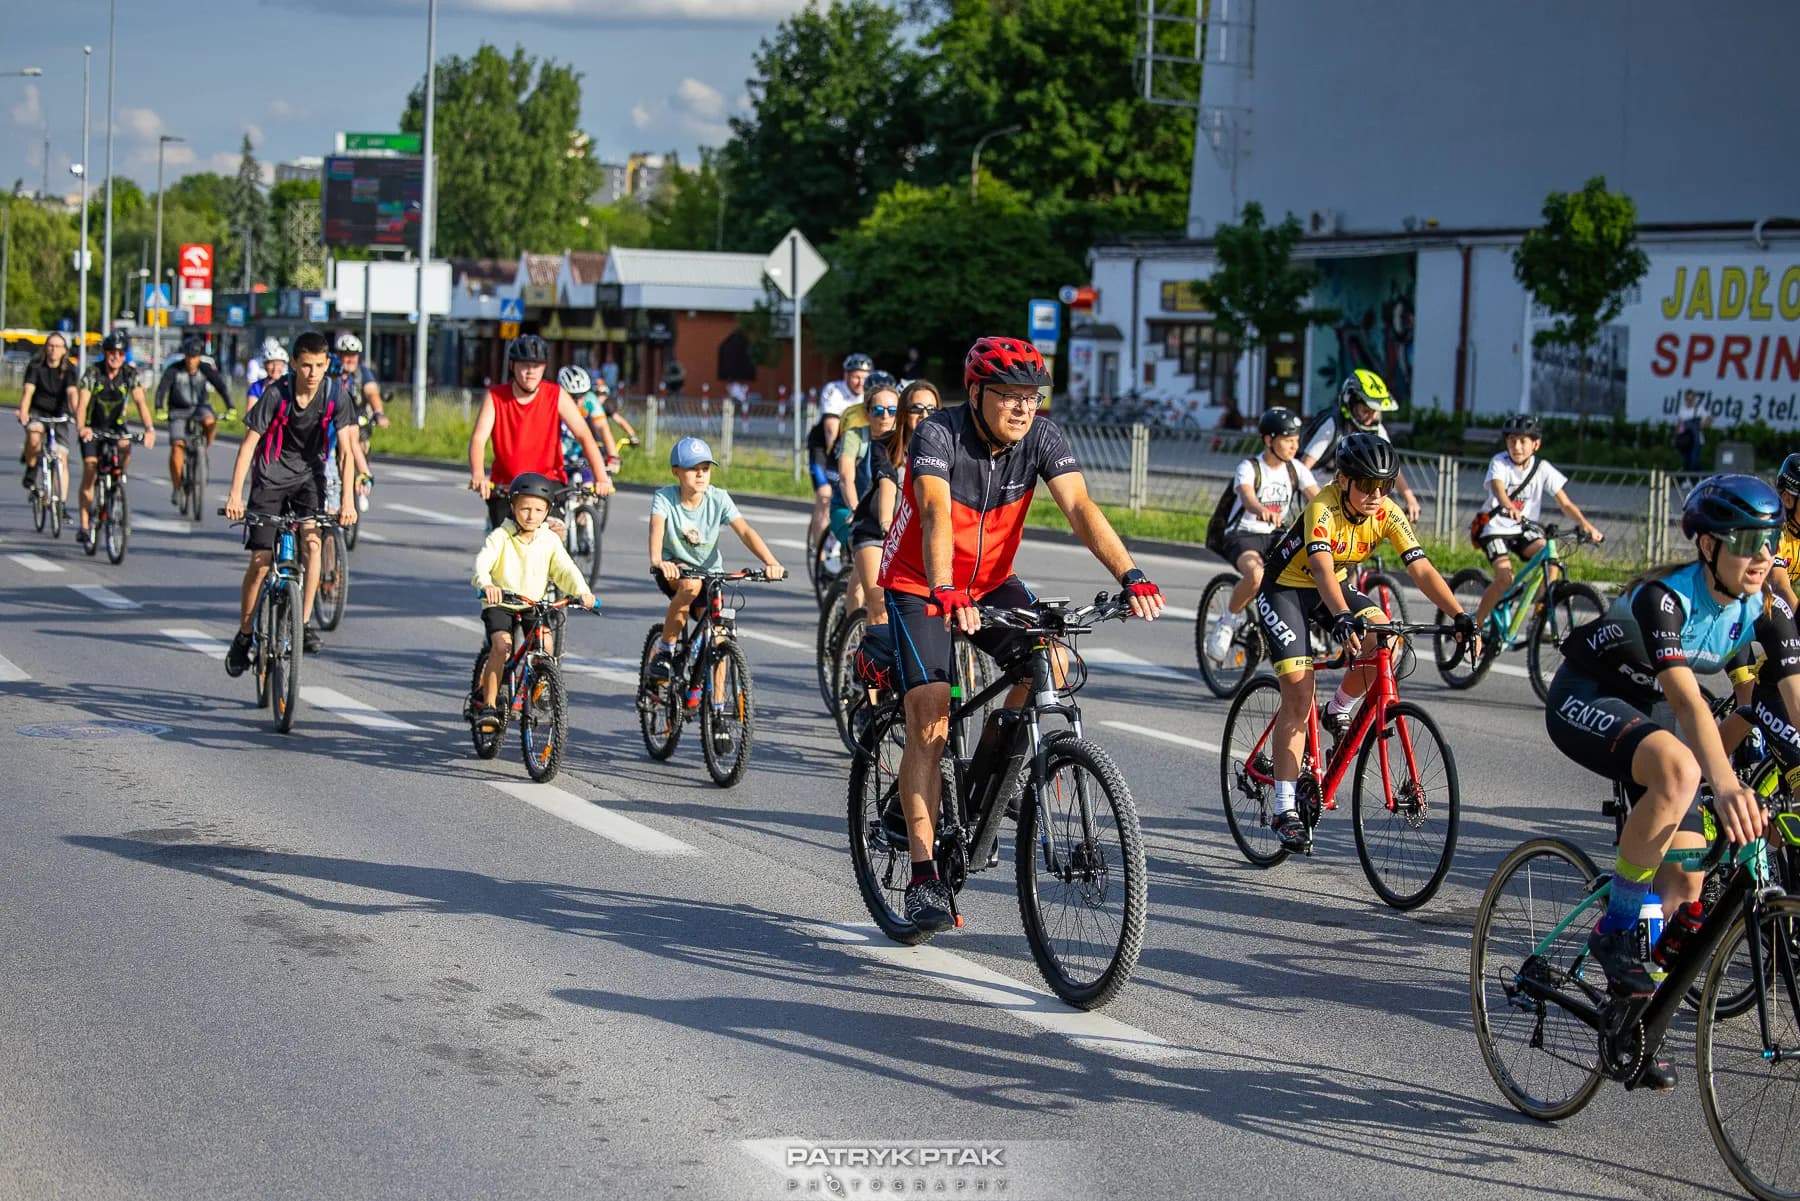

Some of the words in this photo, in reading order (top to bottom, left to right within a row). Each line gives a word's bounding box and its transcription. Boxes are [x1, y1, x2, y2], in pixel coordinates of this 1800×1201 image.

[1749, 393, 1763, 420] 3
[1768, 393, 1798, 420] tel.
[1560, 696, 1615, 731] VENTO
